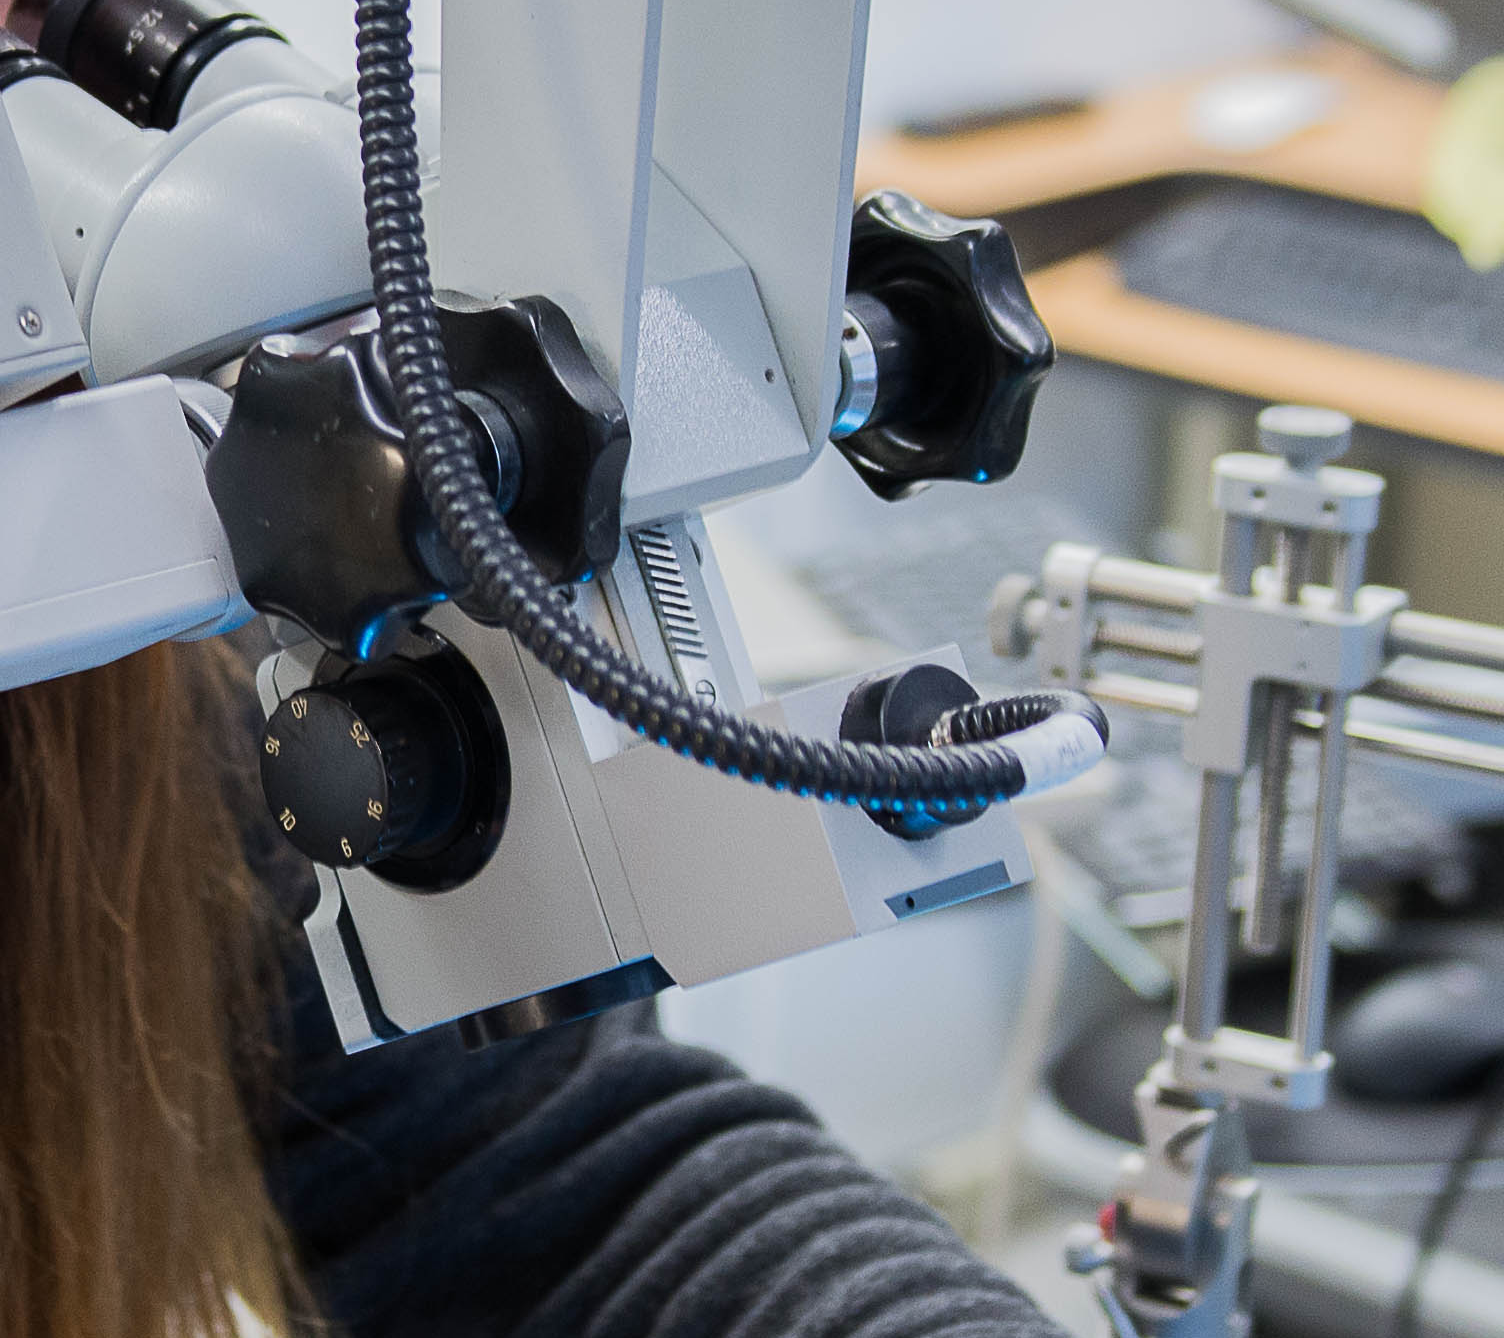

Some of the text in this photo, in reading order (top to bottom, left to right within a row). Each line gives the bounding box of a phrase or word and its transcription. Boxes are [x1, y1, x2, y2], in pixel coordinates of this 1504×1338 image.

[349, 719, 371, 750] 25
[279, 806, 296, 832] 10
[367, 797, 383, 821] 16
